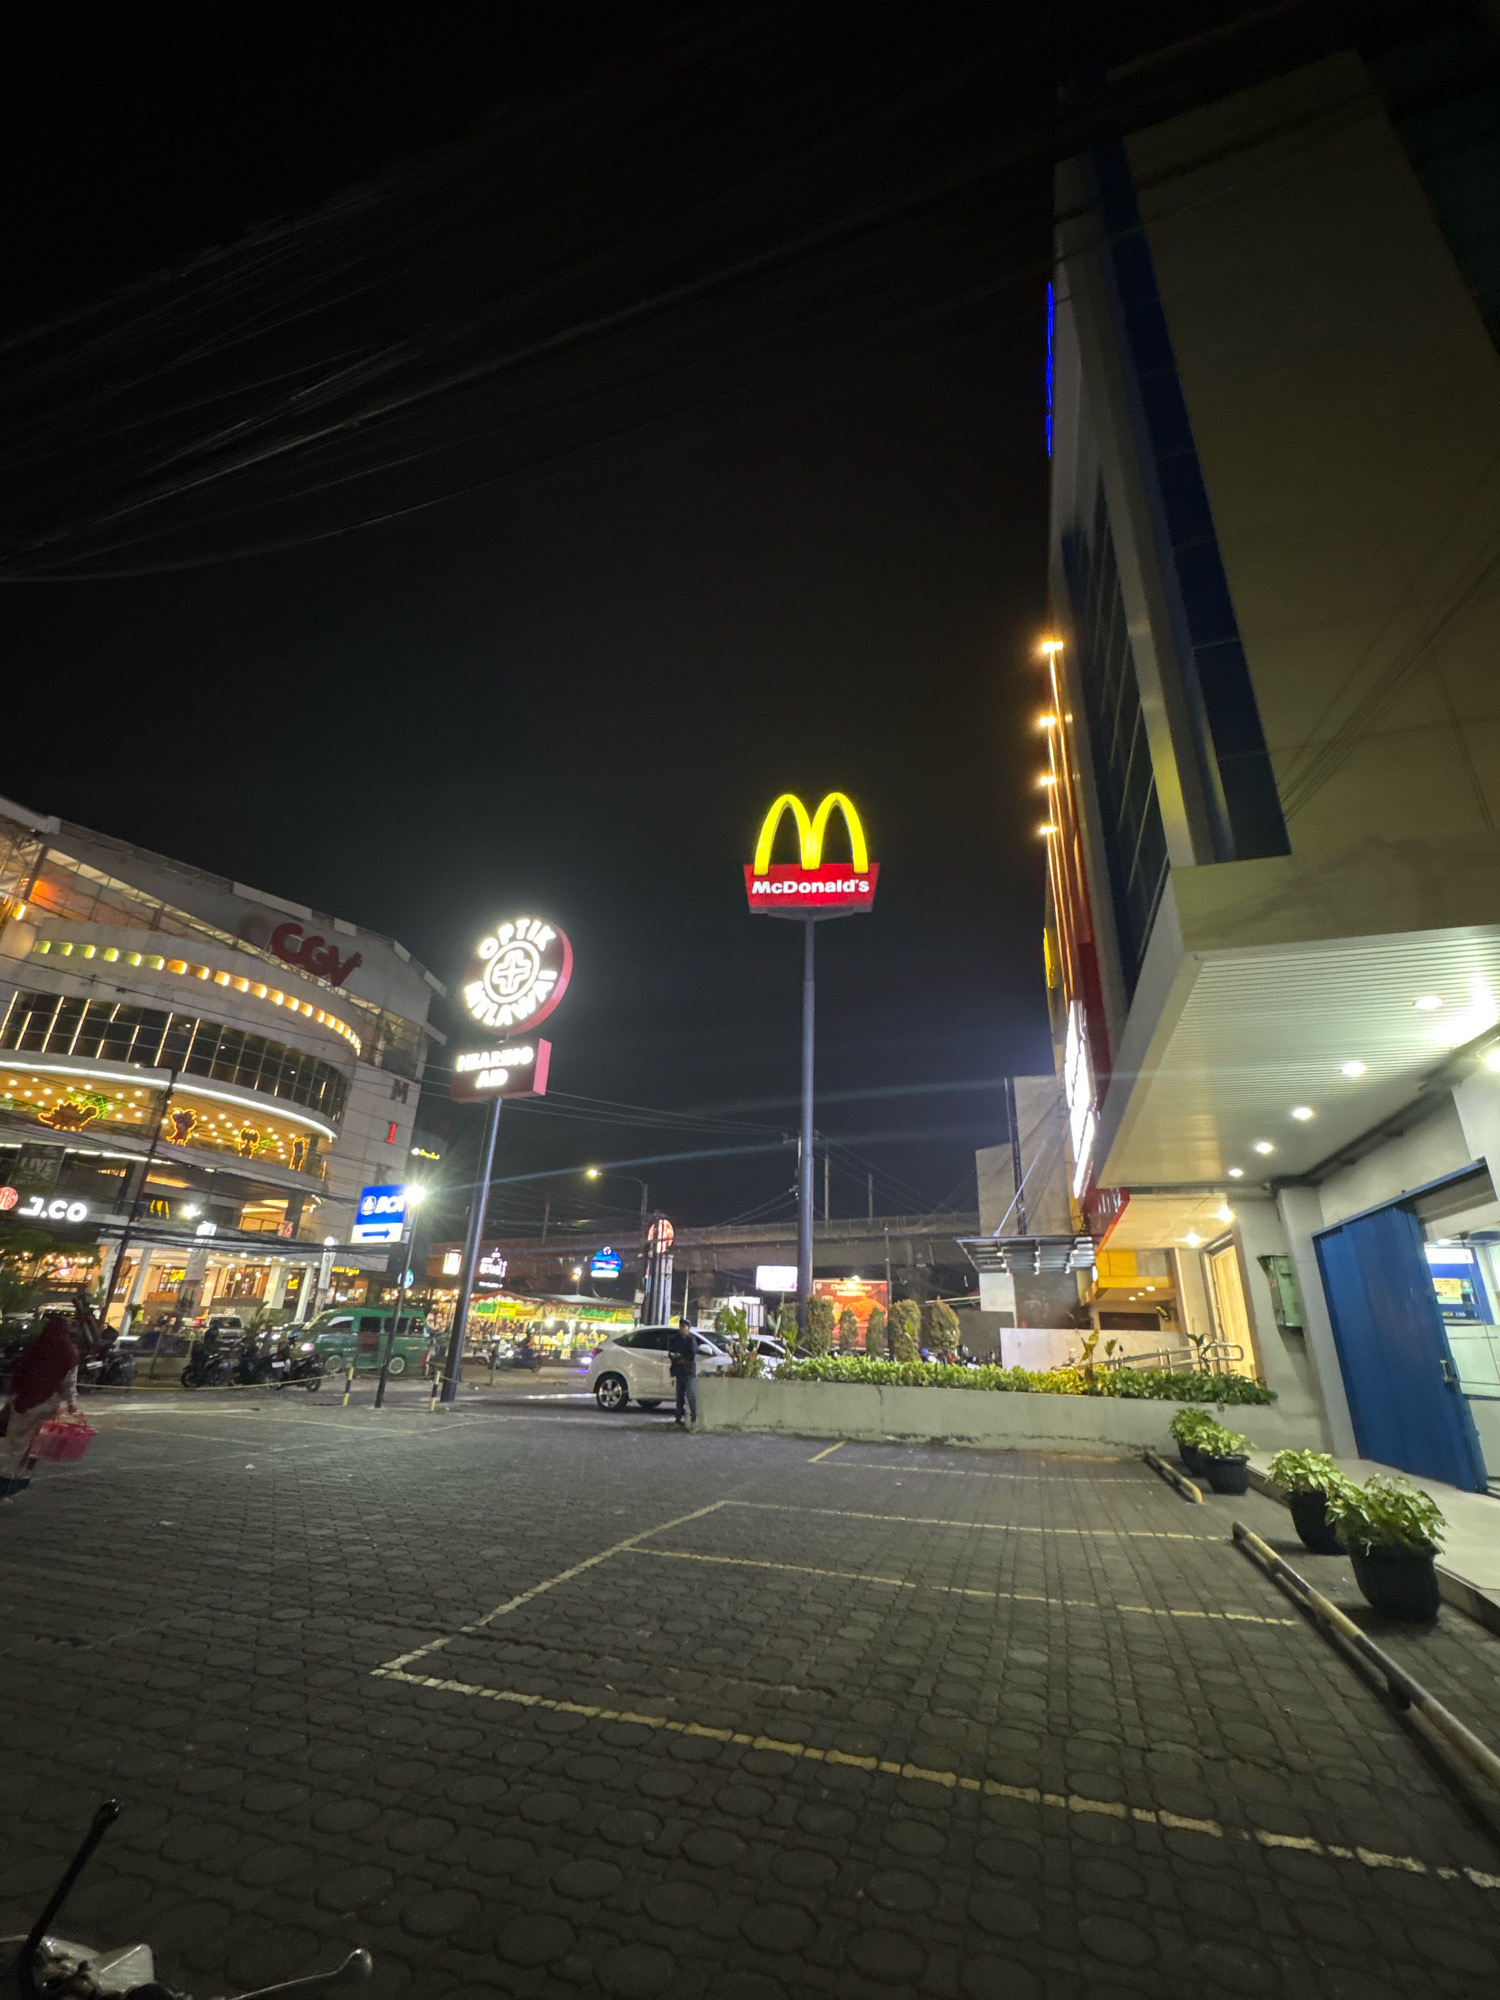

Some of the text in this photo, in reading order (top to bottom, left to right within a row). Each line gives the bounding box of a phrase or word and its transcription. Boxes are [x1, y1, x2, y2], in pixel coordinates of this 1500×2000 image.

[751, 879, 870, 894] McDonald's
[479, 918, 556, 960] OPTIK
[271, 922, 362, 987] CGV
[456, 1046, 534, 1072] HEARING
[475, 1068, 509, 1088] AID
[18, 1196, 89, 1222] J.CO
